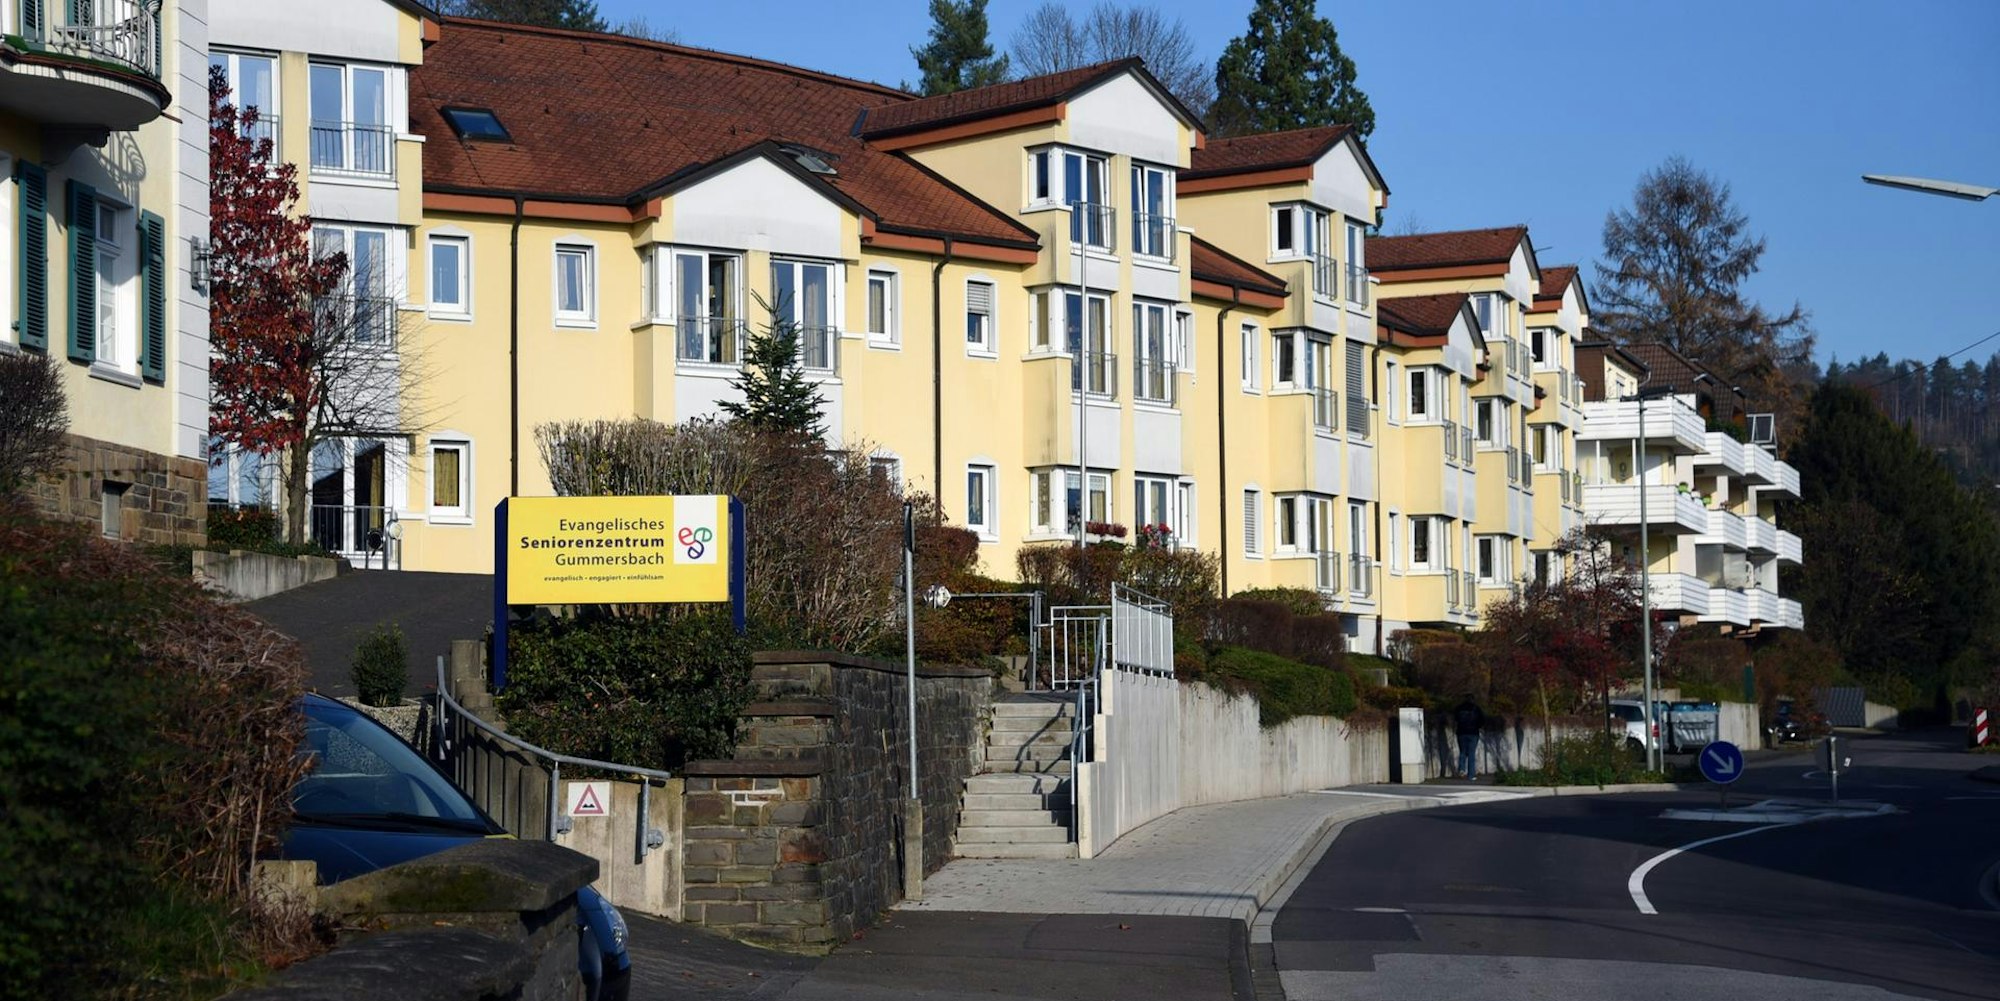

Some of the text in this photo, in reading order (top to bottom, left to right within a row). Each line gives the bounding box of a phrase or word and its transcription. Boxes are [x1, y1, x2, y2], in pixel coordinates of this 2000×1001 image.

[559, 518, 664, 534] Evangelisches
[520, 536, 664, 548] Seniorenzentrum
[555, 552, 664, 566] Gummersbach
